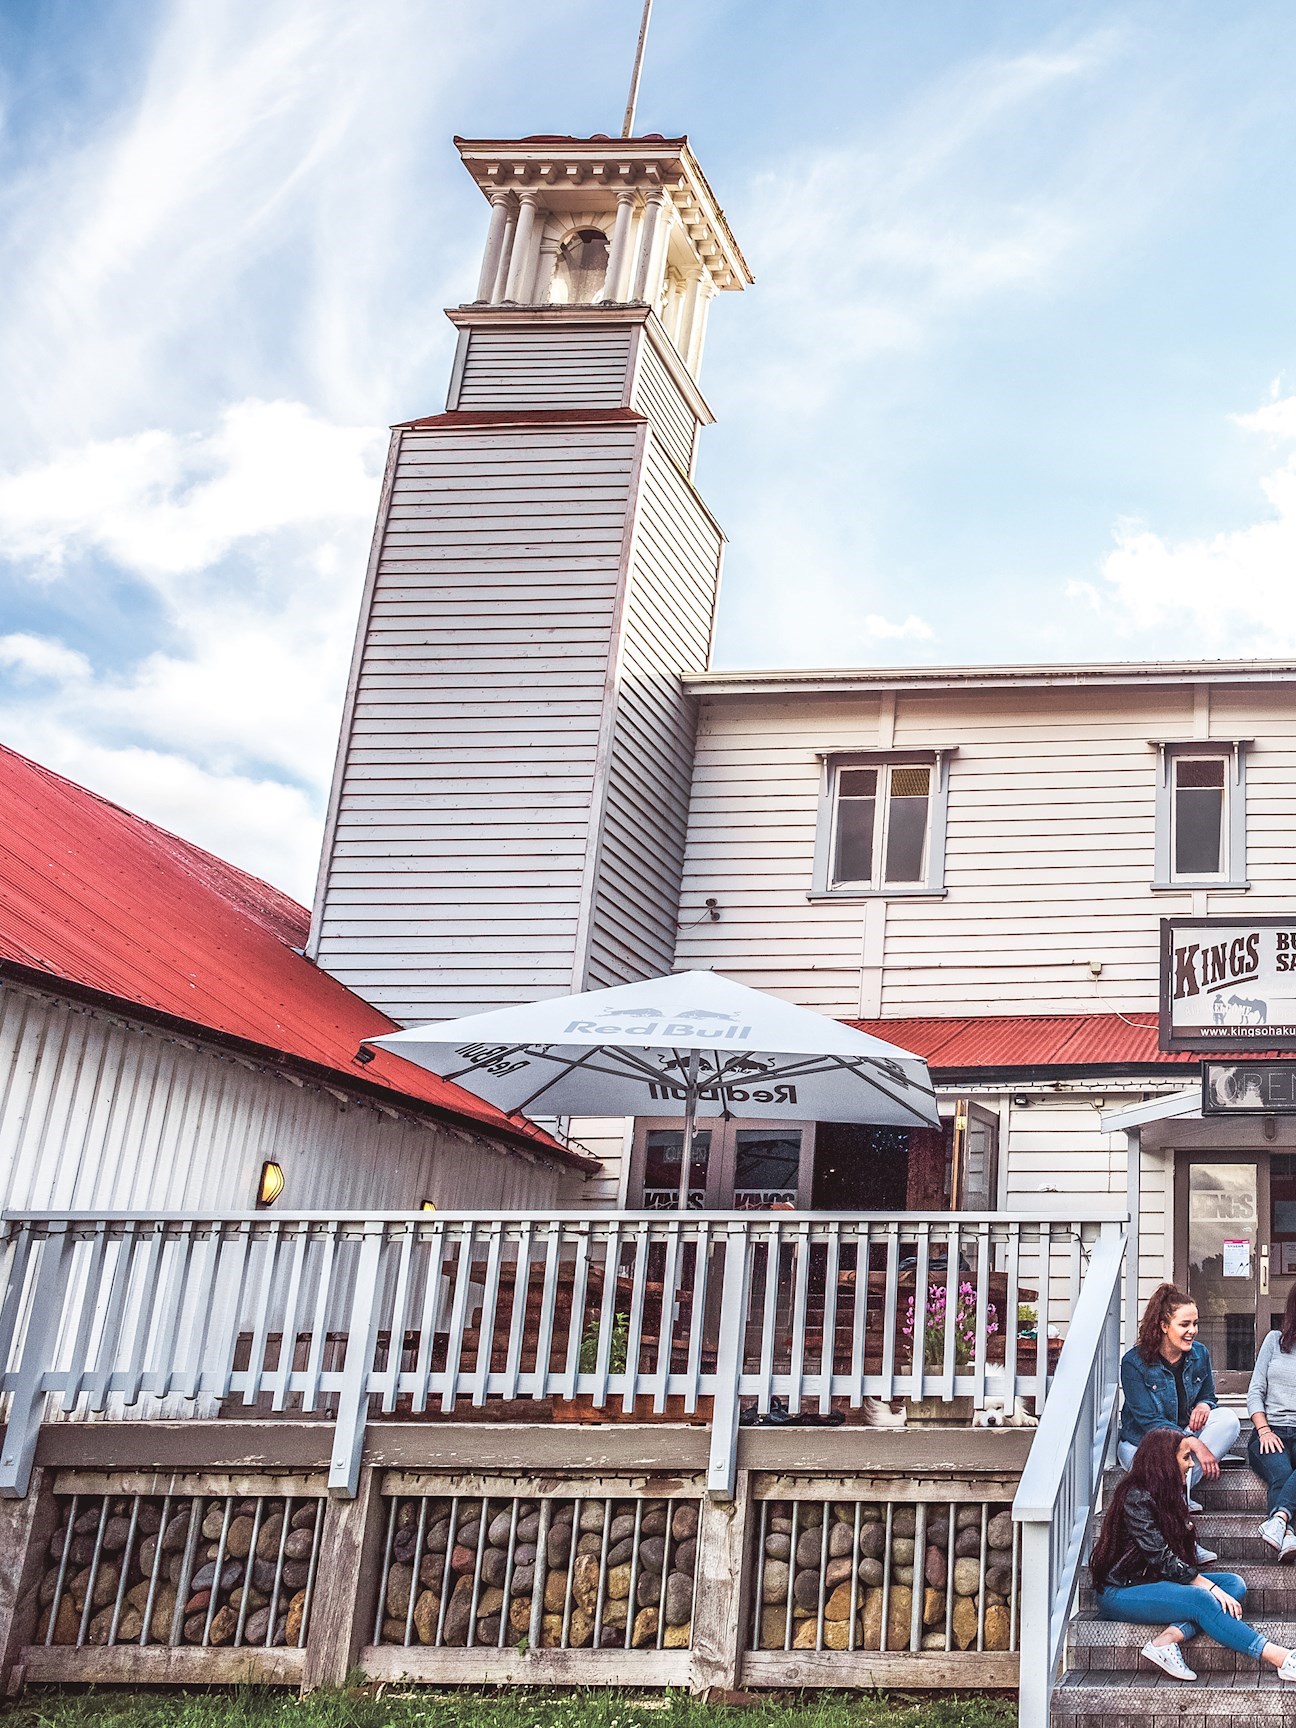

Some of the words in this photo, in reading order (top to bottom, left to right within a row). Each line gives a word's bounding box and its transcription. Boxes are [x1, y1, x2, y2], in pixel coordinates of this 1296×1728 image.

[1174, 933, 1260, 1000] KINGS
[563, 1021, 658, 1036] Red
[662, 1023, 752, 1040] Bull
[645, 1192, 704, 1210] KINS
[1192, 1194, 1254, 1219] NGS
